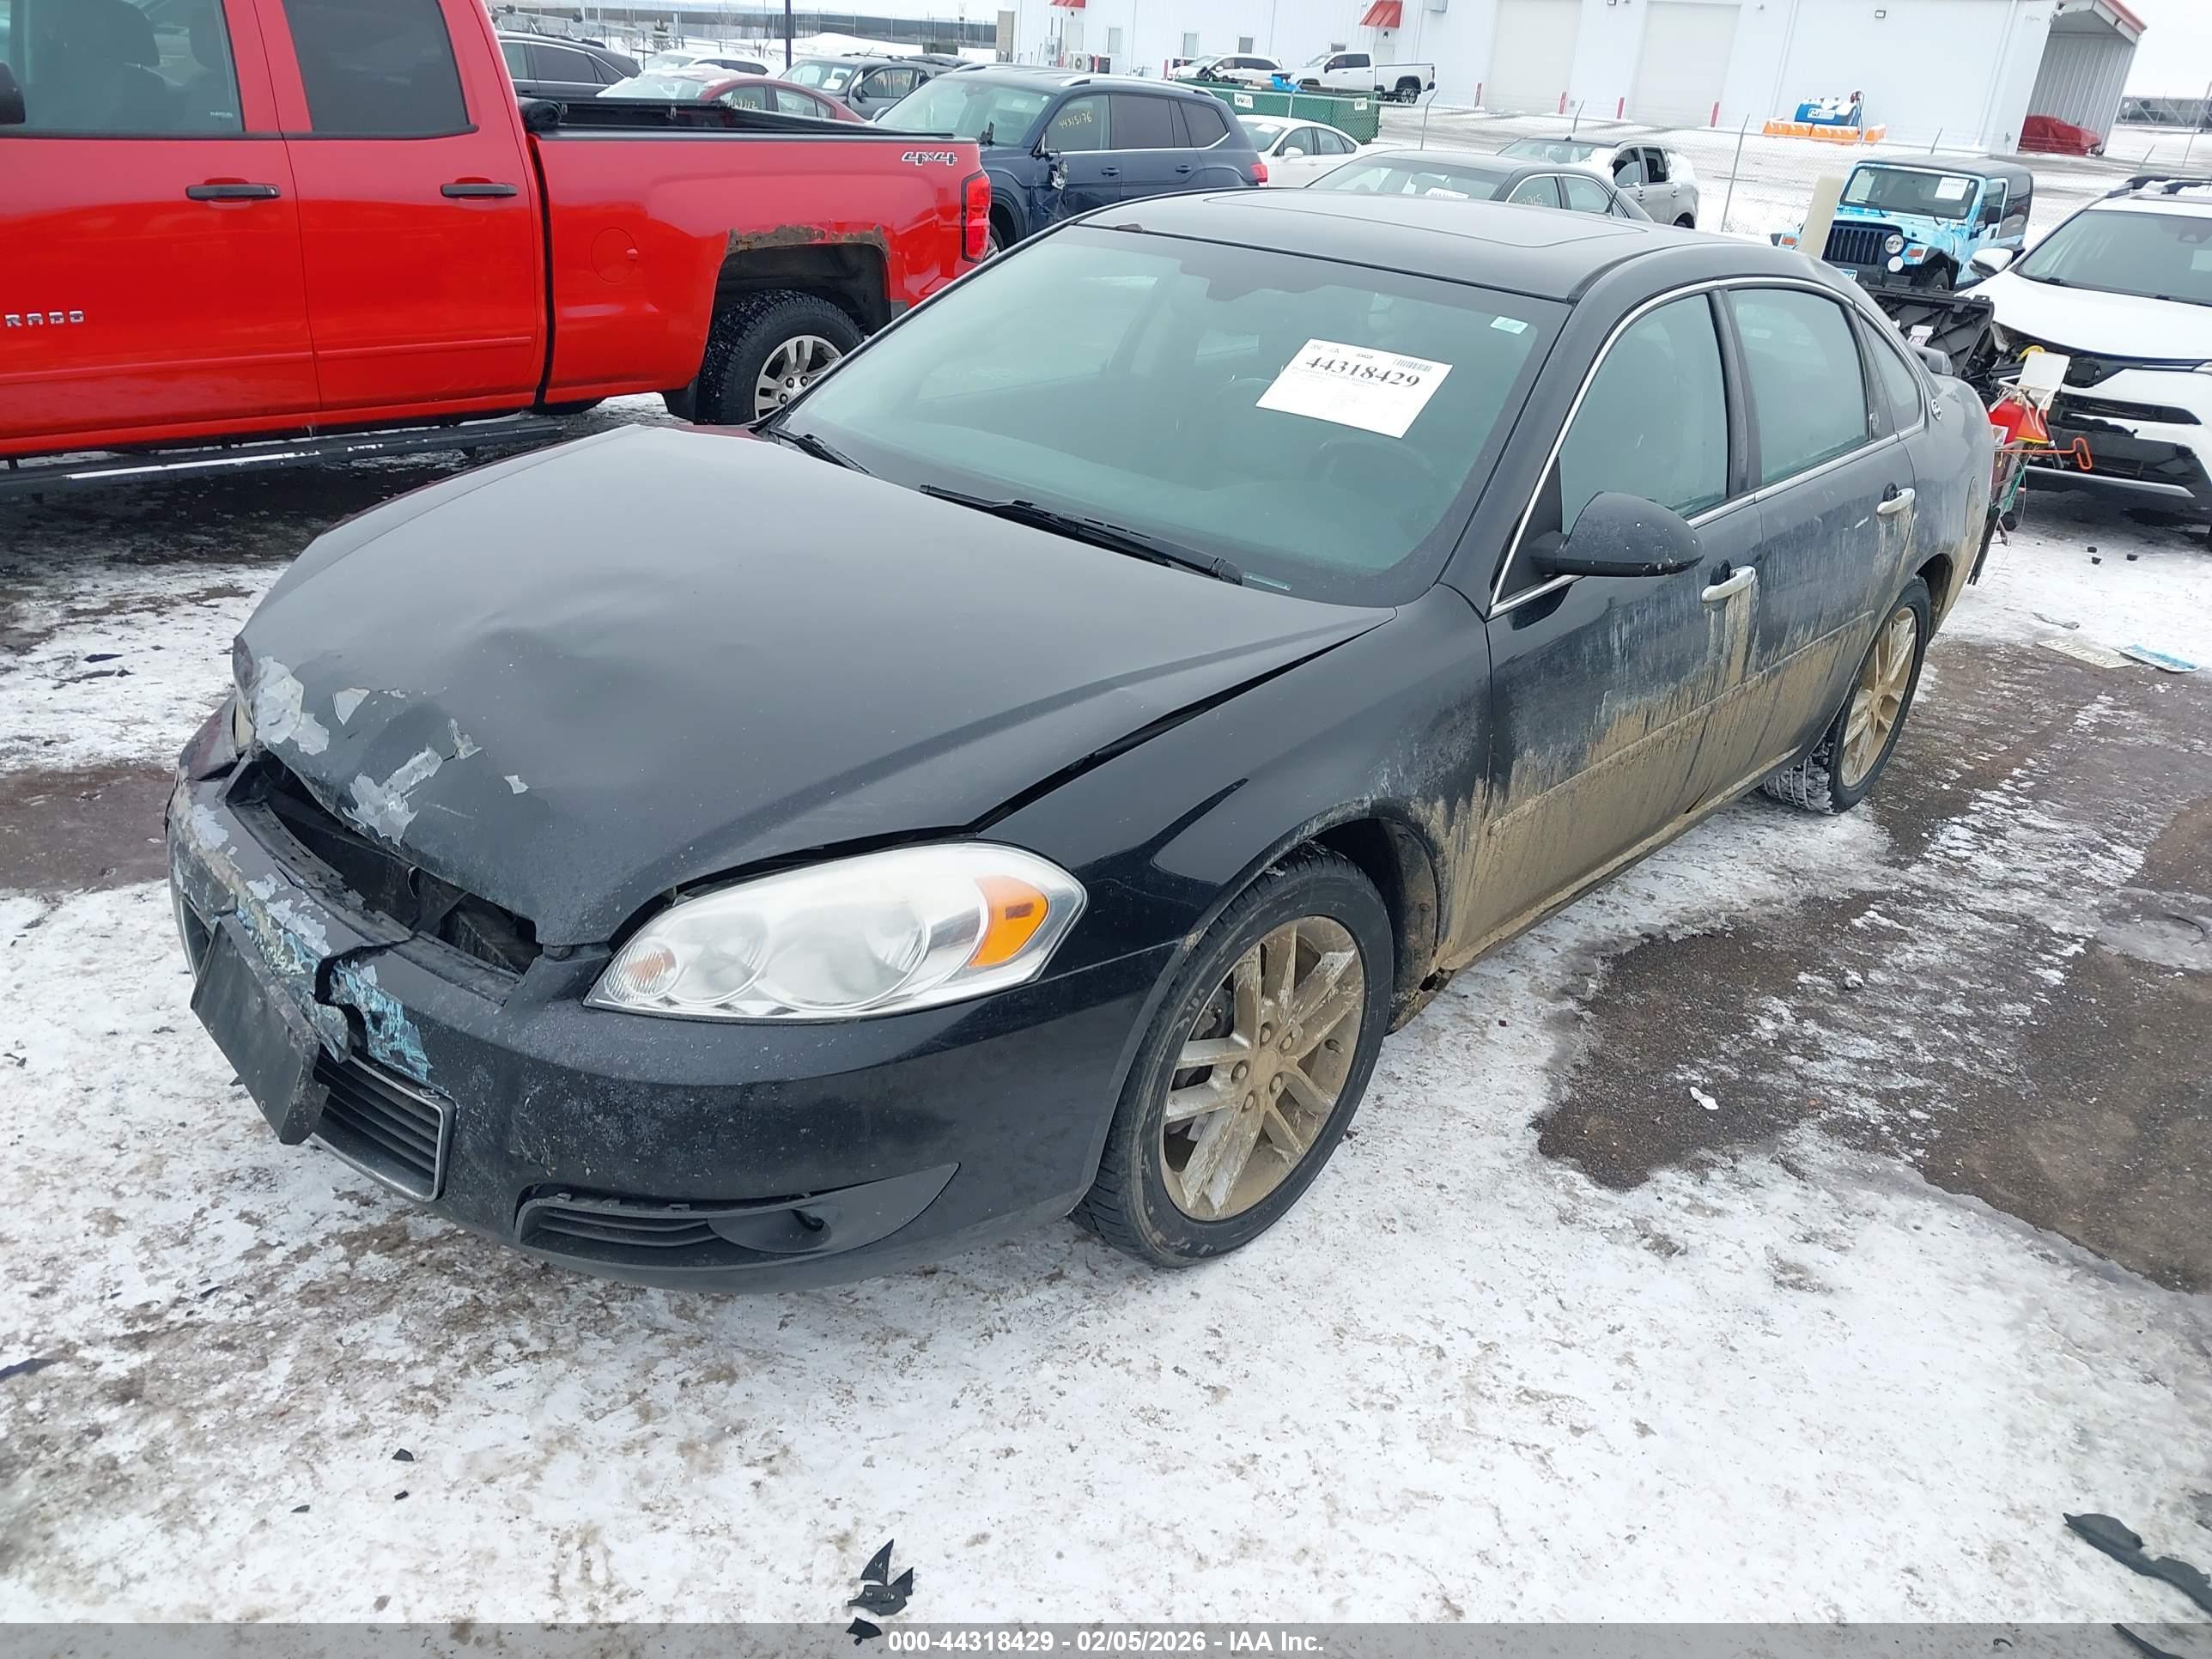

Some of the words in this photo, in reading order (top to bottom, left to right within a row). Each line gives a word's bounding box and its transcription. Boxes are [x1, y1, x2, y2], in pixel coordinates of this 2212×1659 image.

[1059, 110, 1092, 129] 44315176
[4, 310, 84, 327] RADO
[1306, 356, 1420, 387] 44318429
